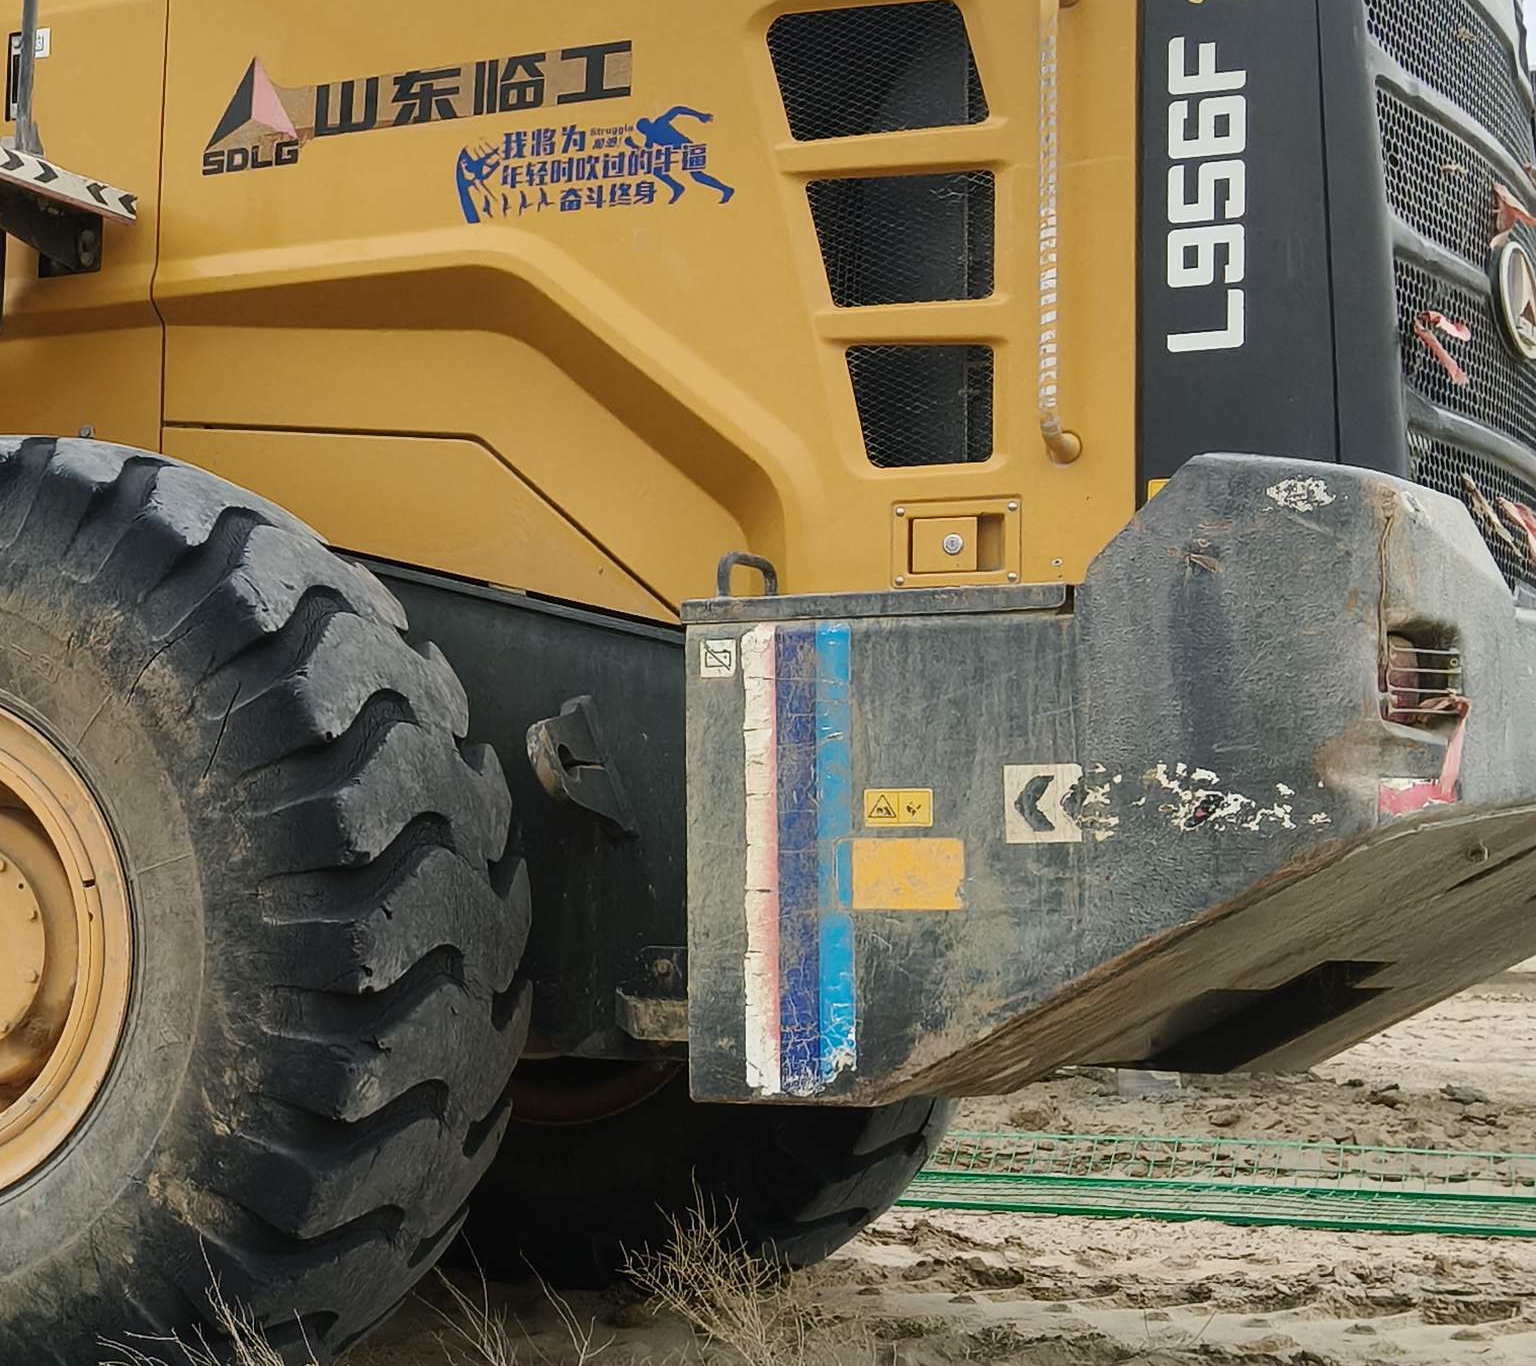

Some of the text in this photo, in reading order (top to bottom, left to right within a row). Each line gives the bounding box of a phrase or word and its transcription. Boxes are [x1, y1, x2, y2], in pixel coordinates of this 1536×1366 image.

[313, 39, 633, 137] 山东临工
[202, 138, 300, 176] SDLG
[501, 124, 587, 161] 我将为
[559, 180, 658, 212] 奋斗终身
[1166, 35, 1248, 353] L956F
